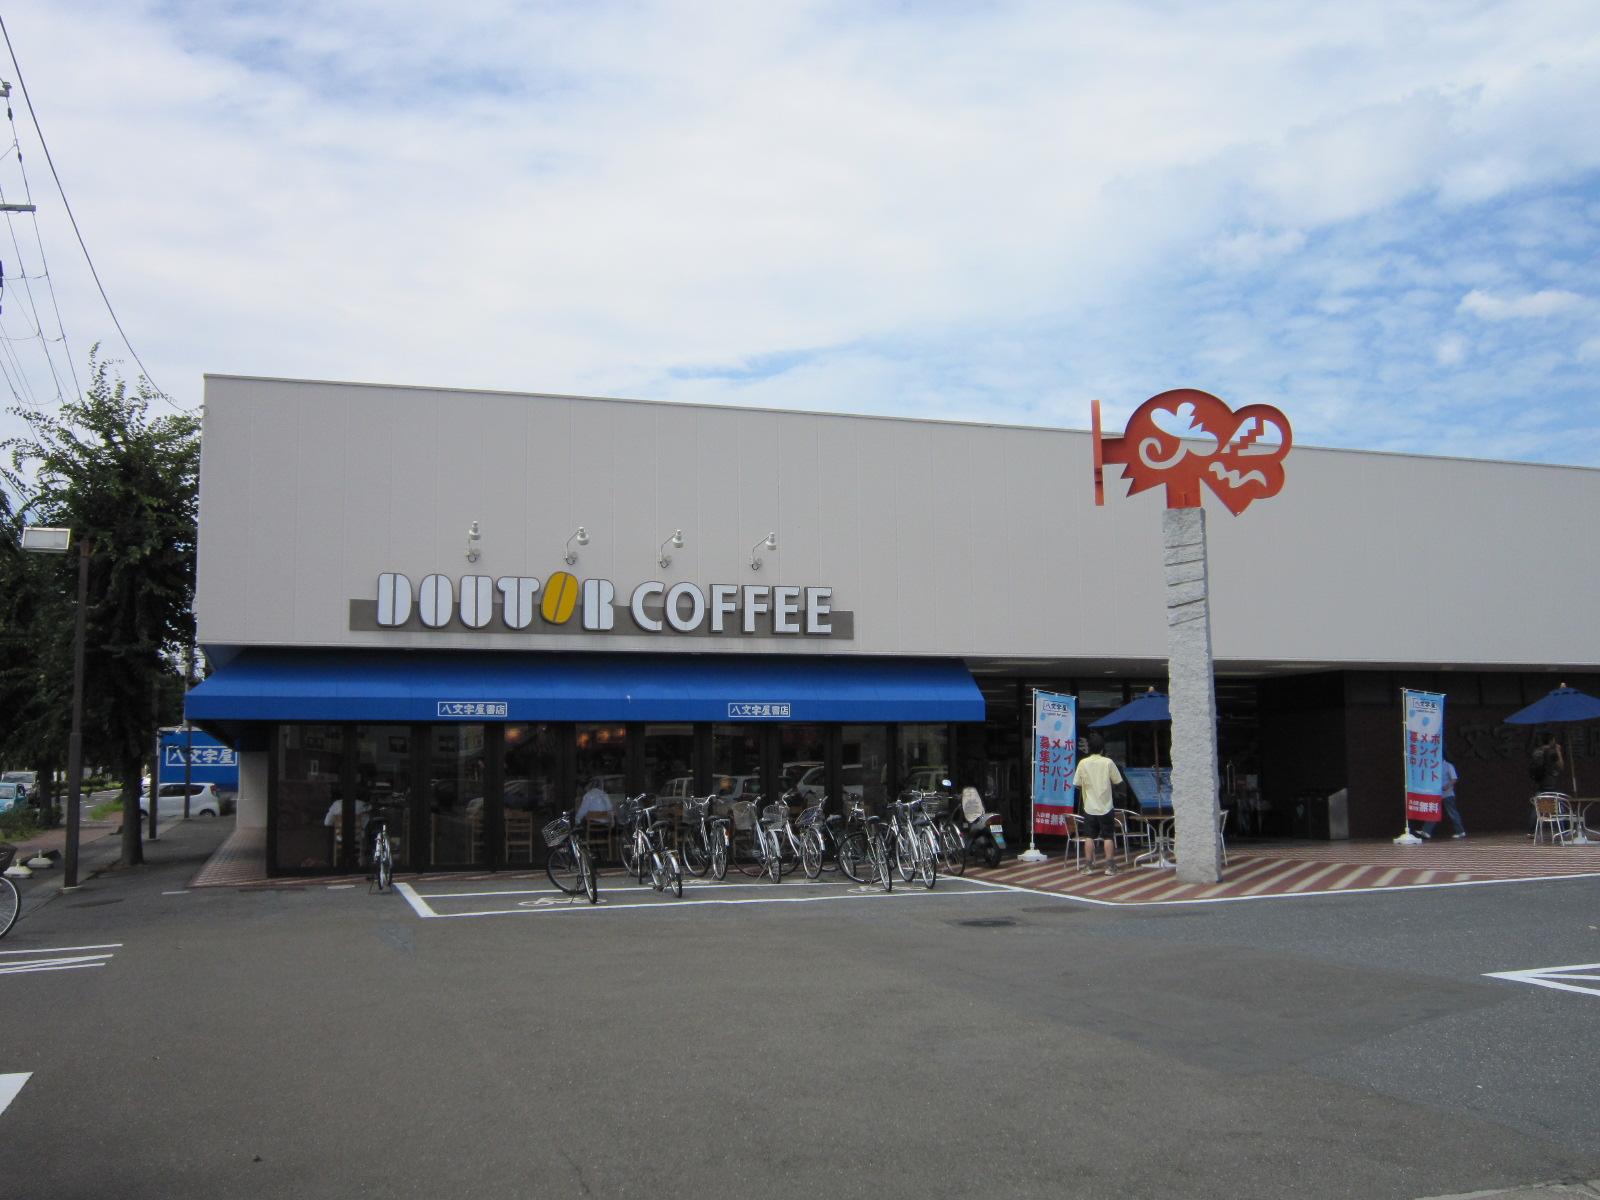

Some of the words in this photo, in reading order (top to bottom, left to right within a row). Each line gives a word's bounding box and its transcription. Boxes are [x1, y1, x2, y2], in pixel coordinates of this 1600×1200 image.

[377, 571, 615, 631] DOUTOR
[631, 581, 833, 634] COFFEE
[441, 704, 505, 714] 八文字屋書店
[731, 705, 788, 715] 八文字屋書店
[169, 749, 234, 763] 八文字屋
[1052, 738, 1061, 791] メンバー
[1063, 739, 1074, 791] ポイント
[1419, 734, 1429, 781] メンバー
[1430, 734, 1440, 782] ポイント
